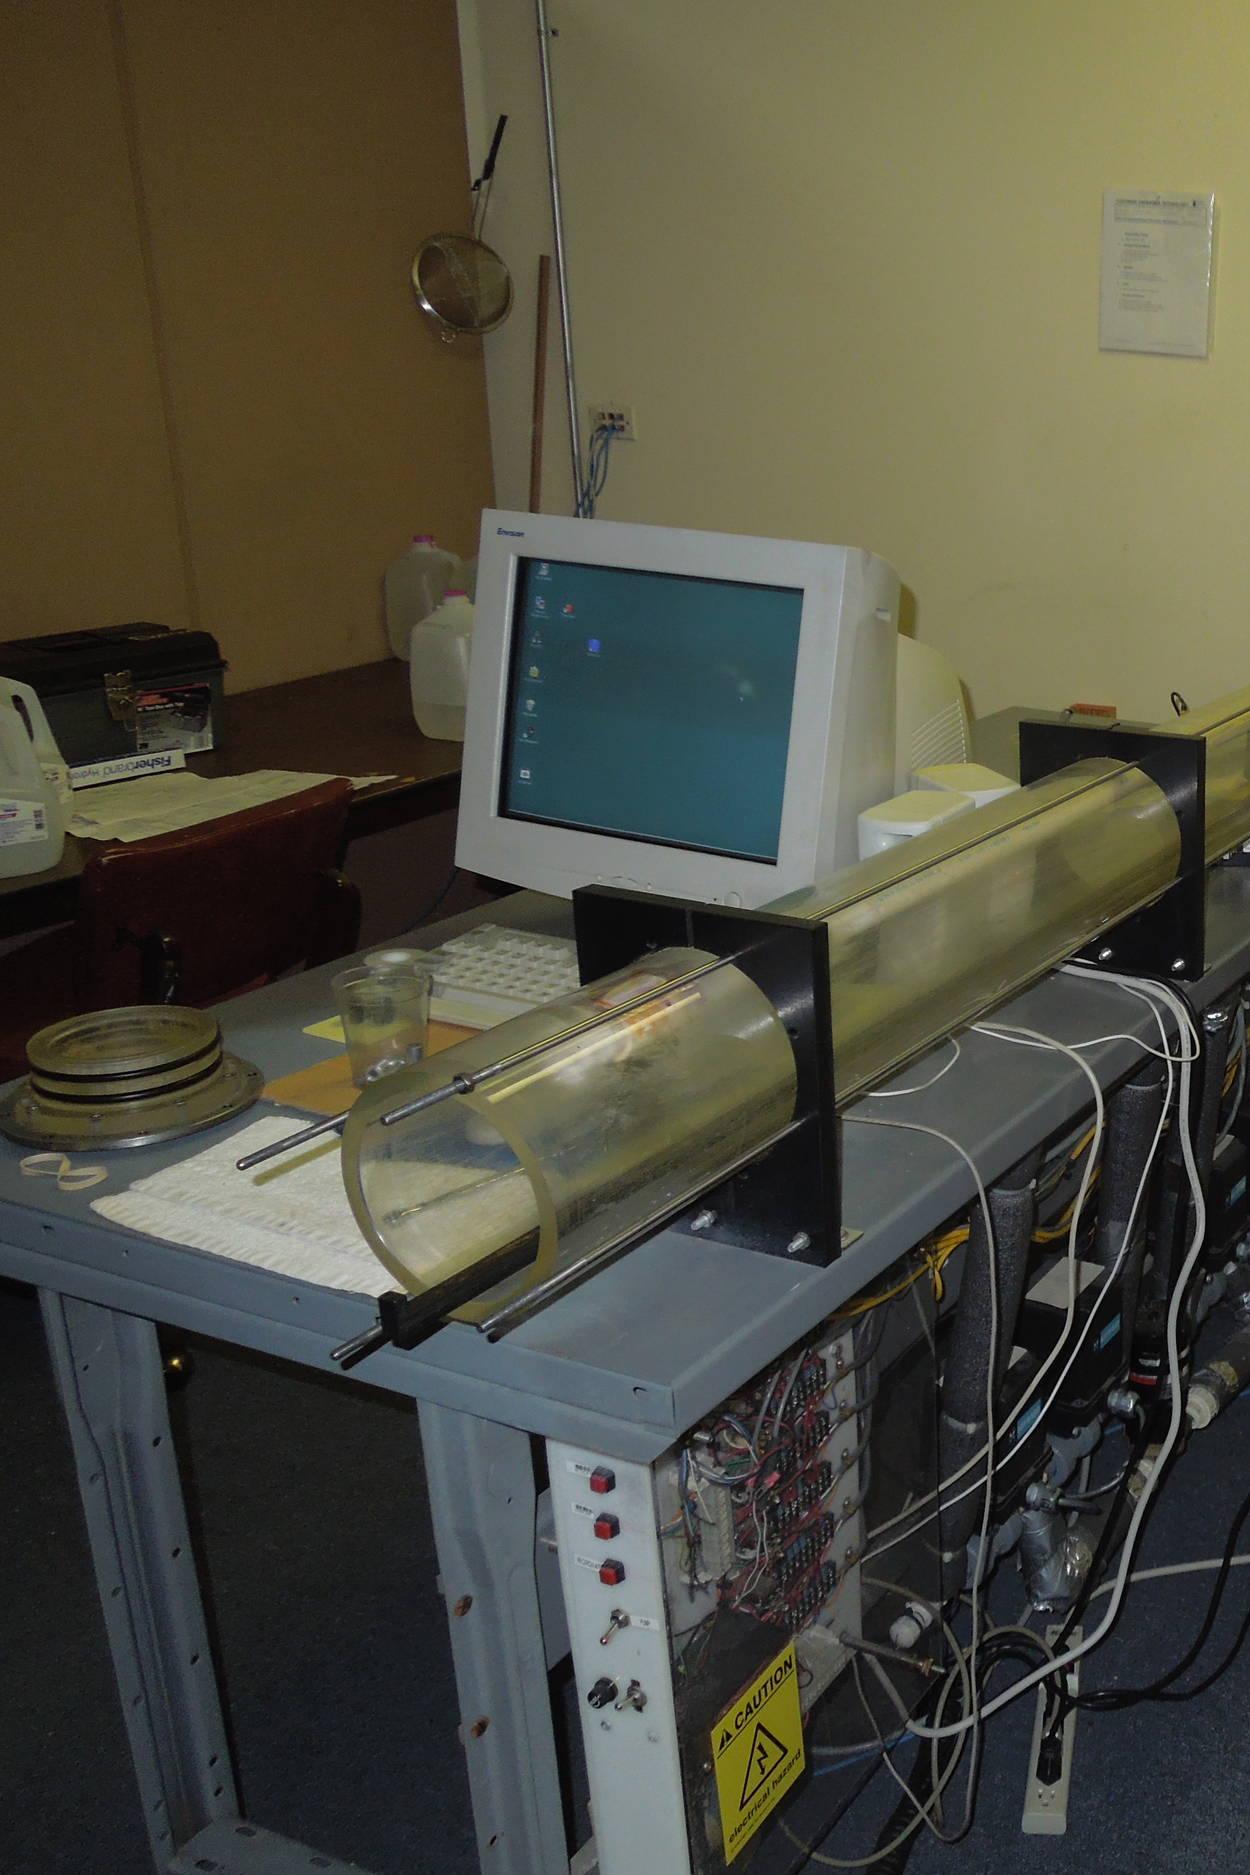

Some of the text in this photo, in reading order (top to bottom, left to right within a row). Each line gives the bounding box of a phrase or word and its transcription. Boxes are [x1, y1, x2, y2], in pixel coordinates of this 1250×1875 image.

[734, 1654, 793, 1729] CAUTION
[728, 1786, 770, 1843] electrical
[771, 1748, 801, 1789] hazard
